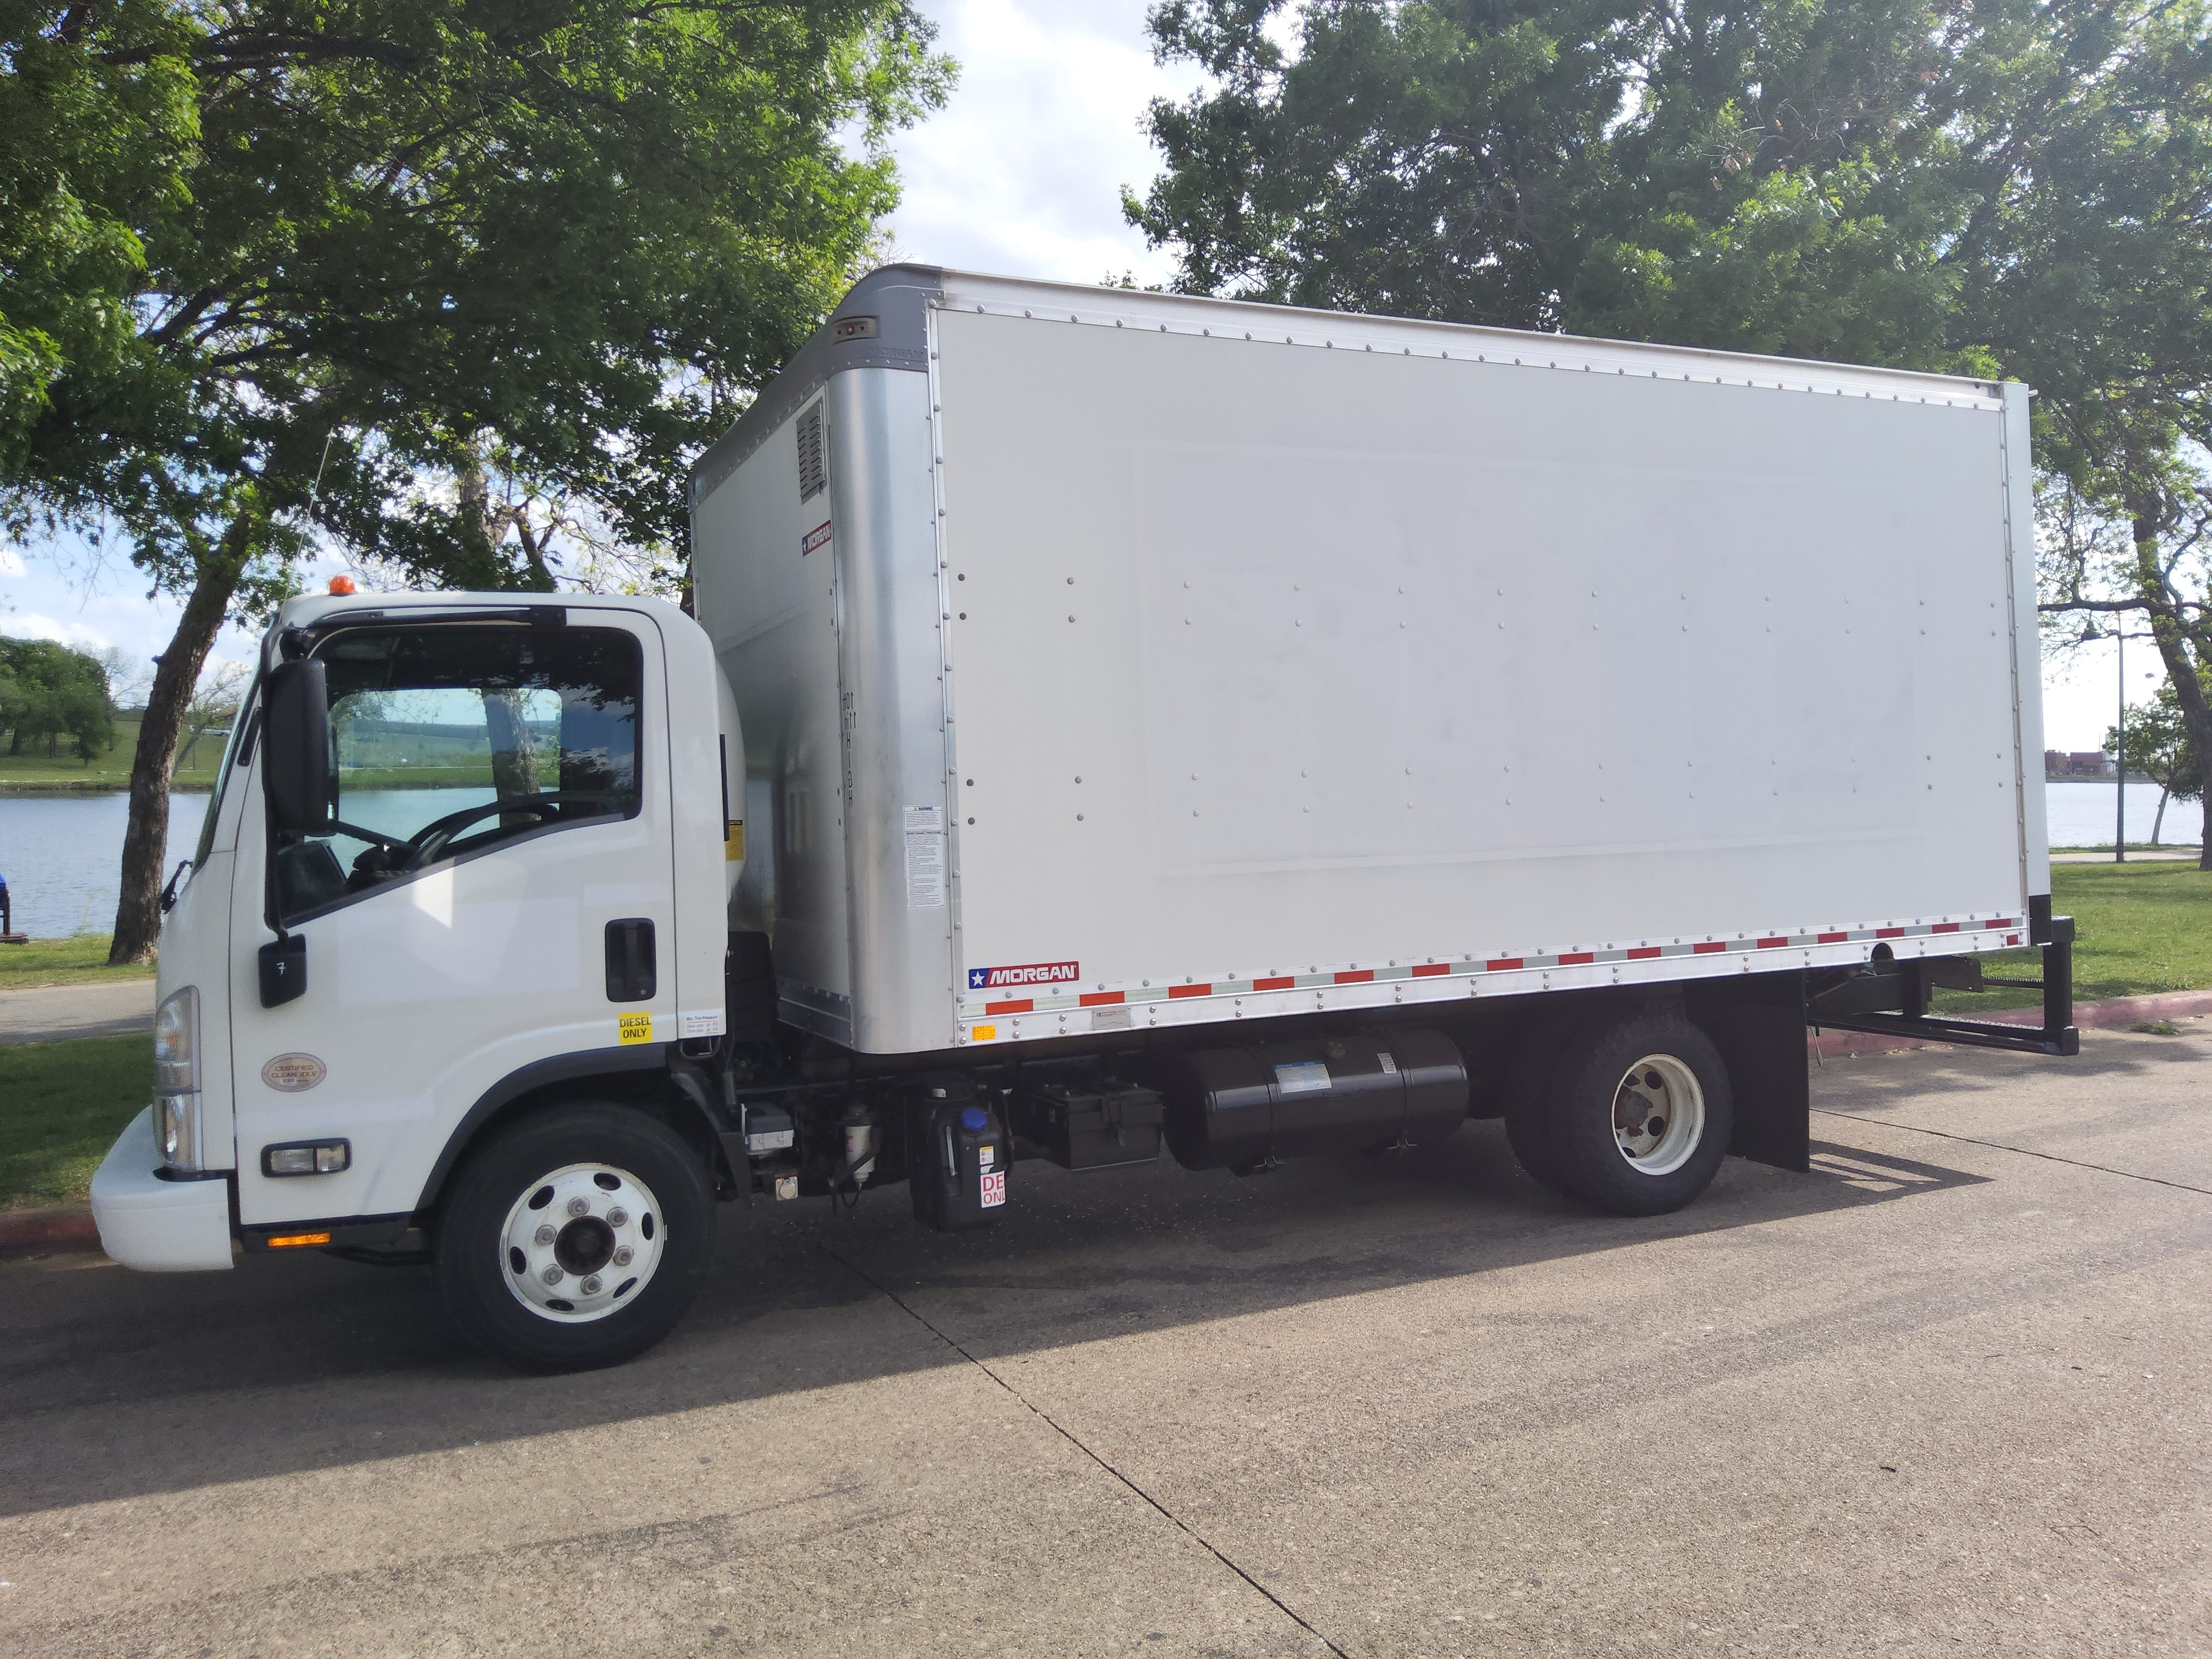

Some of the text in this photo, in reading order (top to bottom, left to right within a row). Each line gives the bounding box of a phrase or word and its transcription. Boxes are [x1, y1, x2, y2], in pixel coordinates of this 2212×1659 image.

[807, 524, 831, 551] MORGAN
[276, 962, 286, 975] 7
[989, 965, 1074, 985] MORGAN
[619, 1016, 652, 1028] DIESEL
[623, 1027, 647, 1039] ONLY
